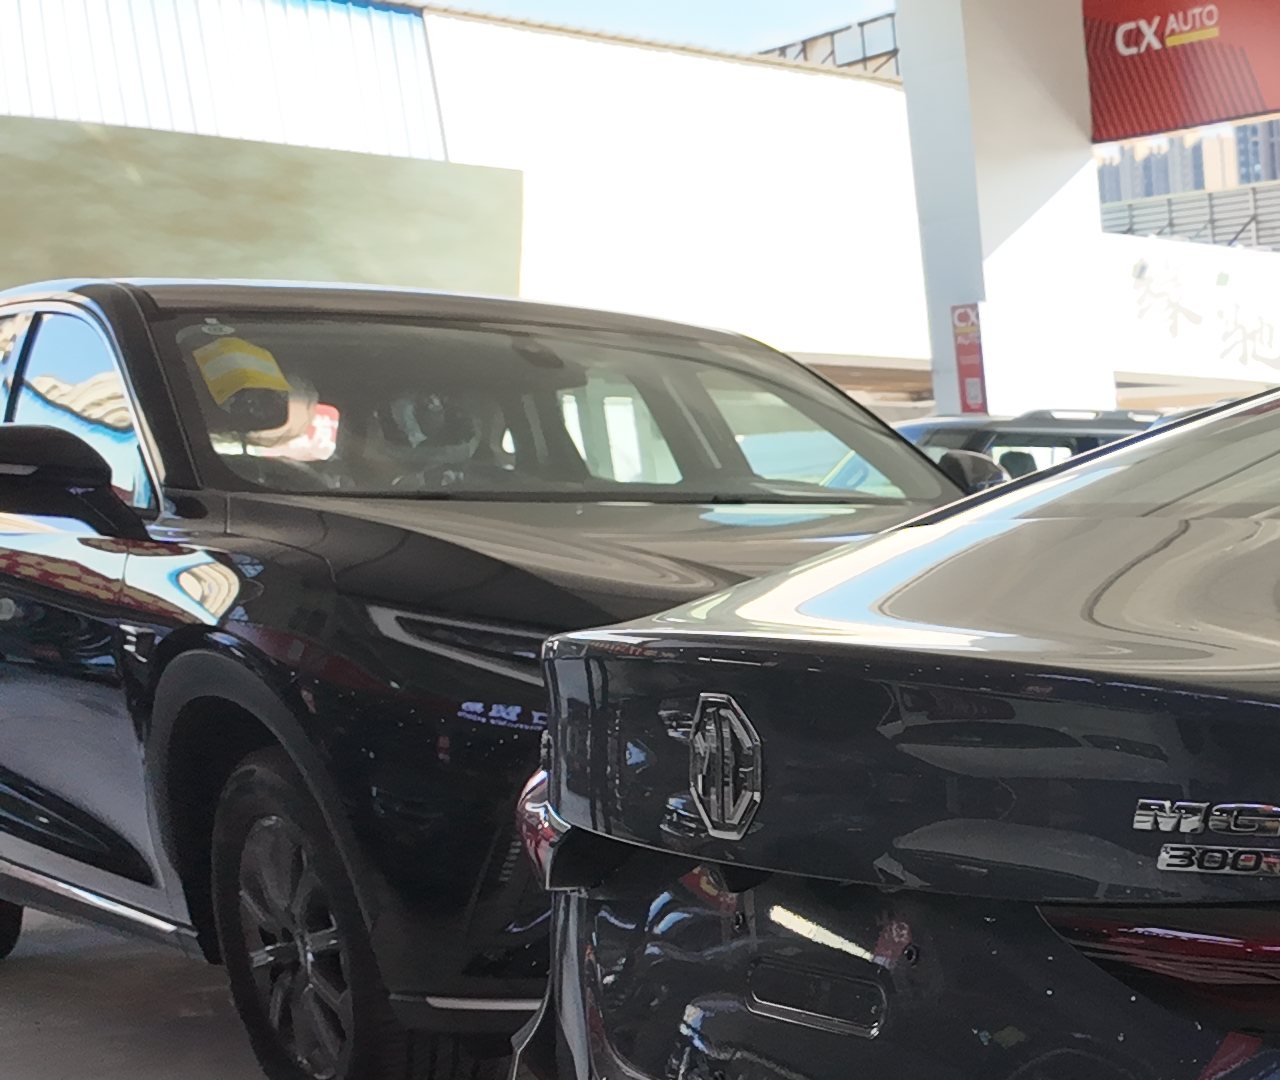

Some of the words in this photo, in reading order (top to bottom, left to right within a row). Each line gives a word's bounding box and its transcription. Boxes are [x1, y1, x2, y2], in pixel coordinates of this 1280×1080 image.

[1115, 16, 1163, 56] CX
[1165, 4, 1219, 36] AUTO
[953, 308, 979, 327] CX
